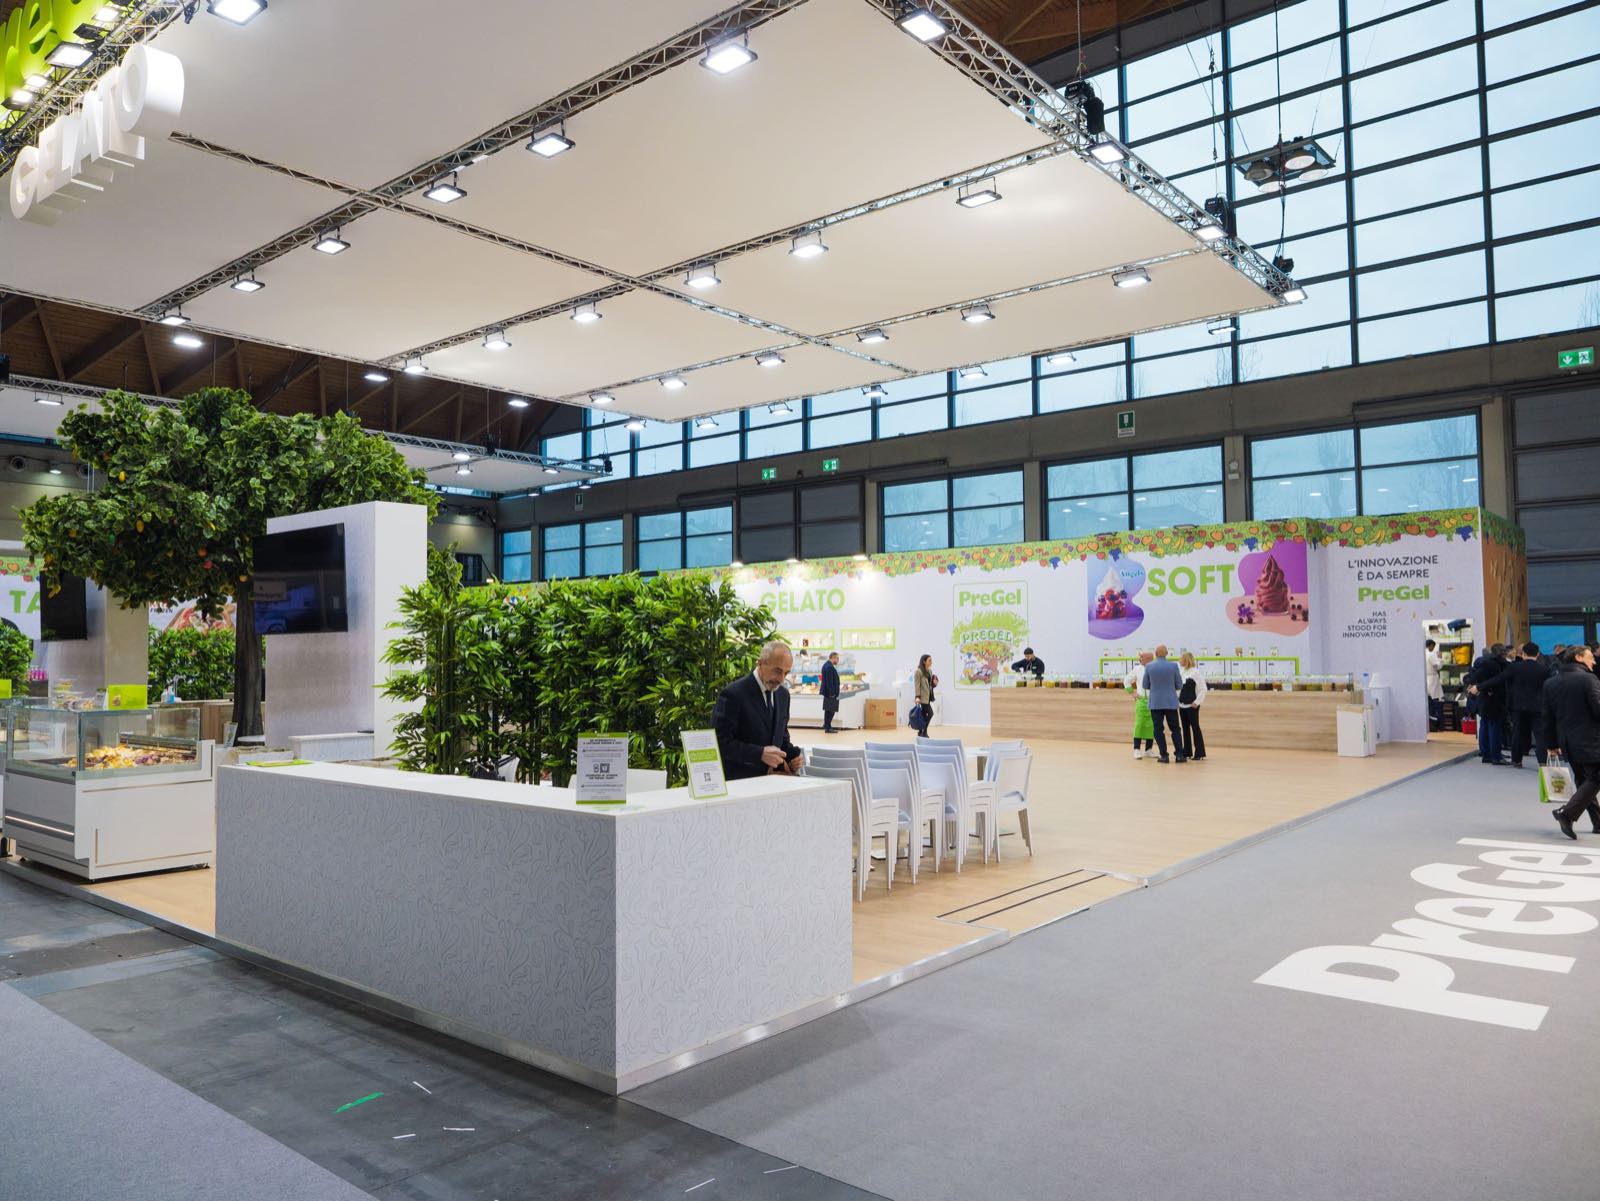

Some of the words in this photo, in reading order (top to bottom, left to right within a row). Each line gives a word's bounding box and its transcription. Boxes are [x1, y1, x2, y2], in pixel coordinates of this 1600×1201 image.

[1348, 555, 1439, 568] L'INNOVAZIONE
[1147, 564, 1235, 596] SOFT
[1367, 571, 1383, 580] DA
[1386, 569, 1429, 580] SEMPRE
[760, 588, 846, 613] GELATO
[959, 588, 1021, 607] PreGel
[1358, 585, 1430, 602] PreGel
